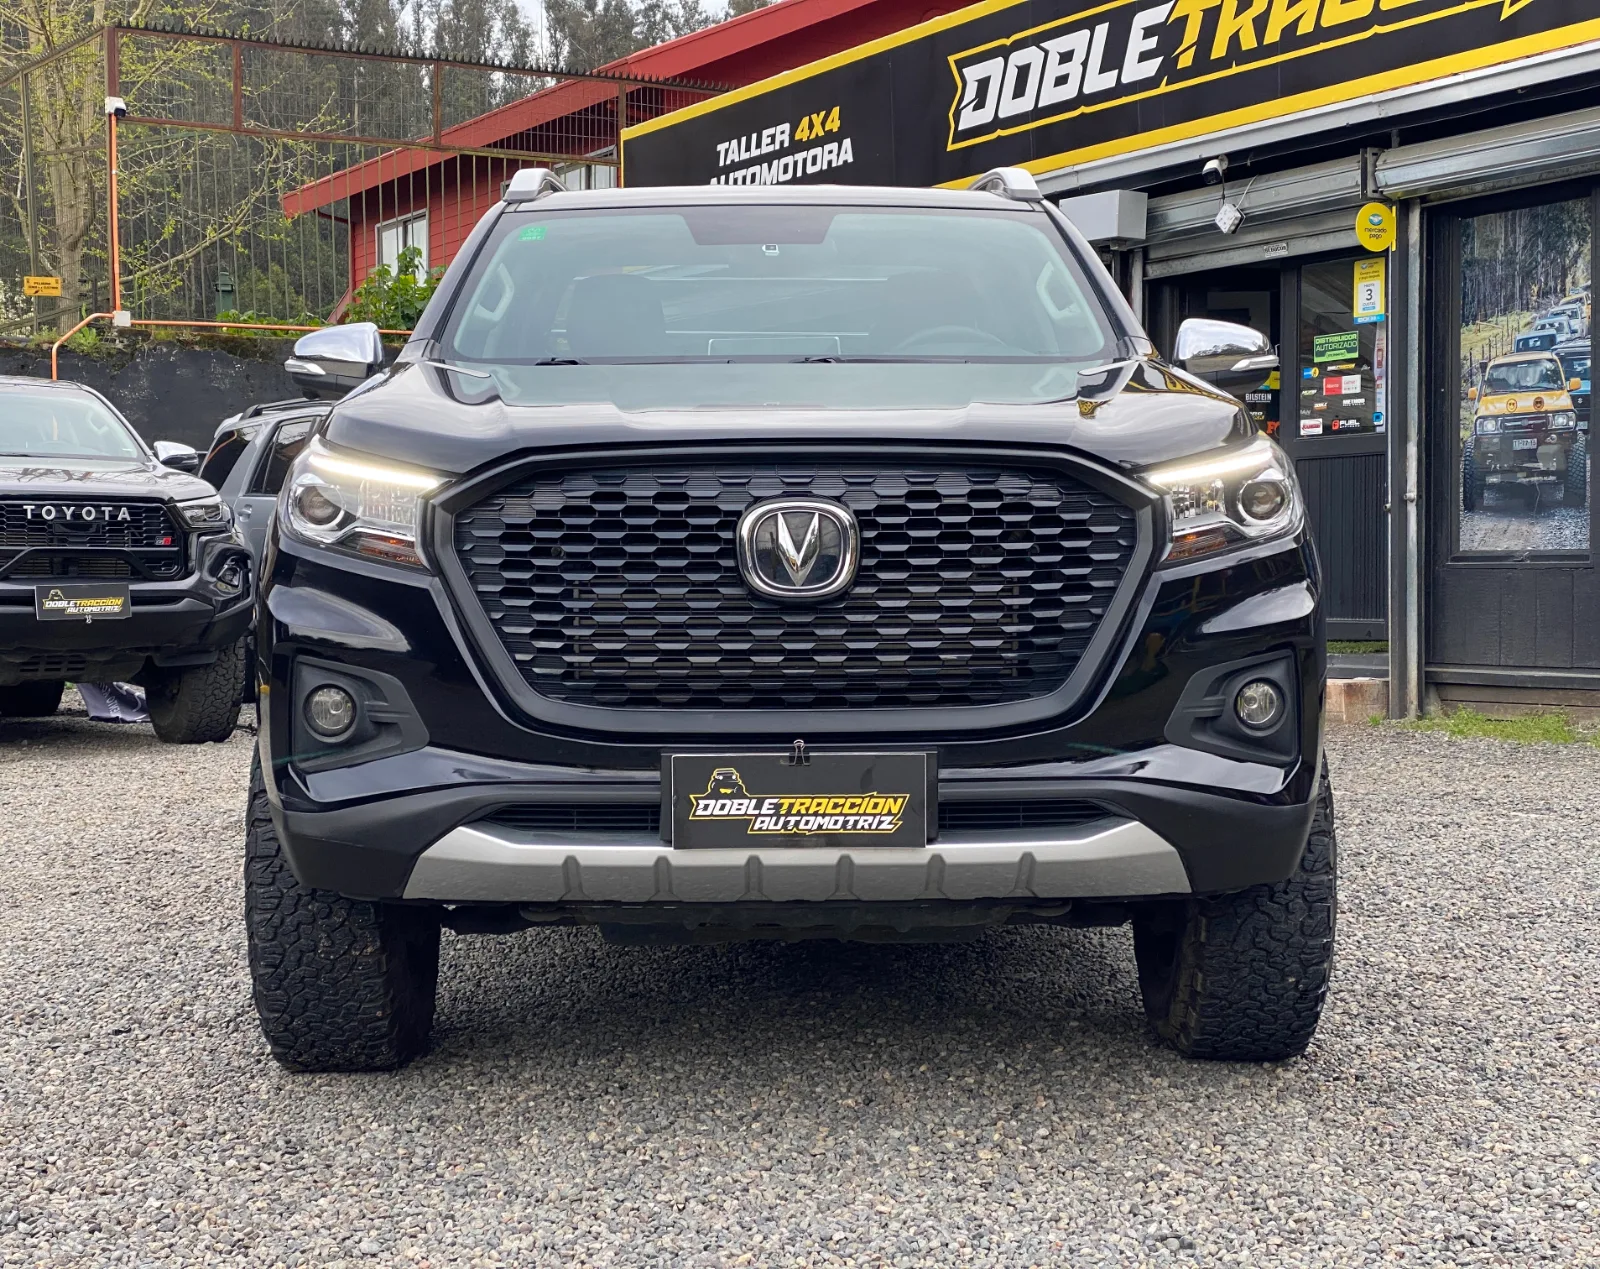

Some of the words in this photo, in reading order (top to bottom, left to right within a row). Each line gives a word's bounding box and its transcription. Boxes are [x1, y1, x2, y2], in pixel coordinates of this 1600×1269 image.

[716, 122, 791, 167] TALLER
[794, 106, 841, 142] 4X4
[1365, 288, 1373, 301] 3
[1315, 333, 1357, 344] DISTRIBUIDOR
[1316, 340, 1358, 351] AUTORIZADO
[1245, 393, 1272, 401] BILSTEIN
[23, 505, 131, 521] TOYOTA
[753, 815, 896, 830] AUTOMOTRIZ
